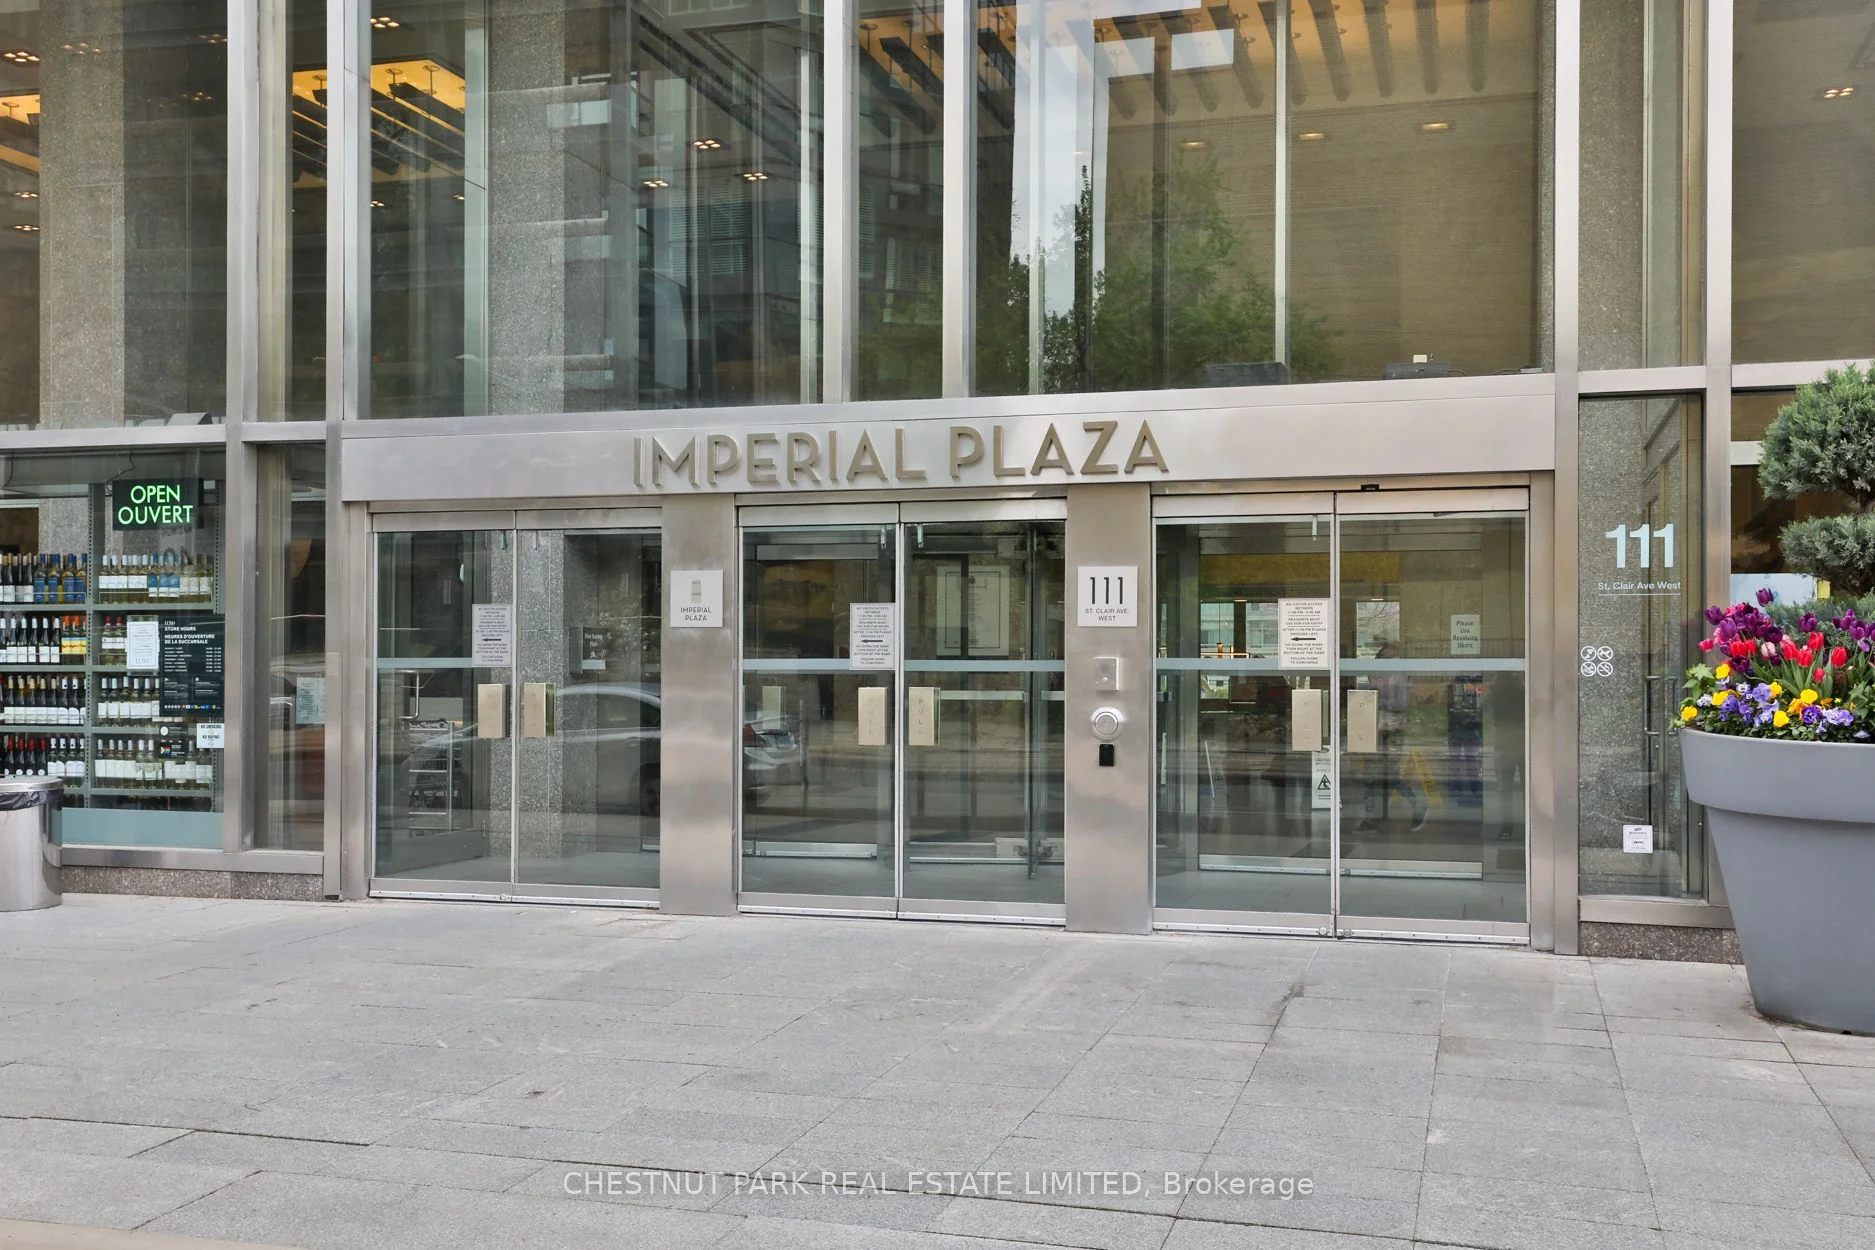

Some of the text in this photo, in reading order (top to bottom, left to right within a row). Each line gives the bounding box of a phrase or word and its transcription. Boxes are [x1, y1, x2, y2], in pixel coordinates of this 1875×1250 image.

[633, 419, 1169, 487] IMPERIAL PLAZA
[130, 484, 180, 504] OPEN
[118, 505, 193, 525] OUVERT
[1605, 523, 1674, 569] 111
[1090, 576, 1123, 605] 111
[1598, 581, 1681, 590] St. Clair Ave West
